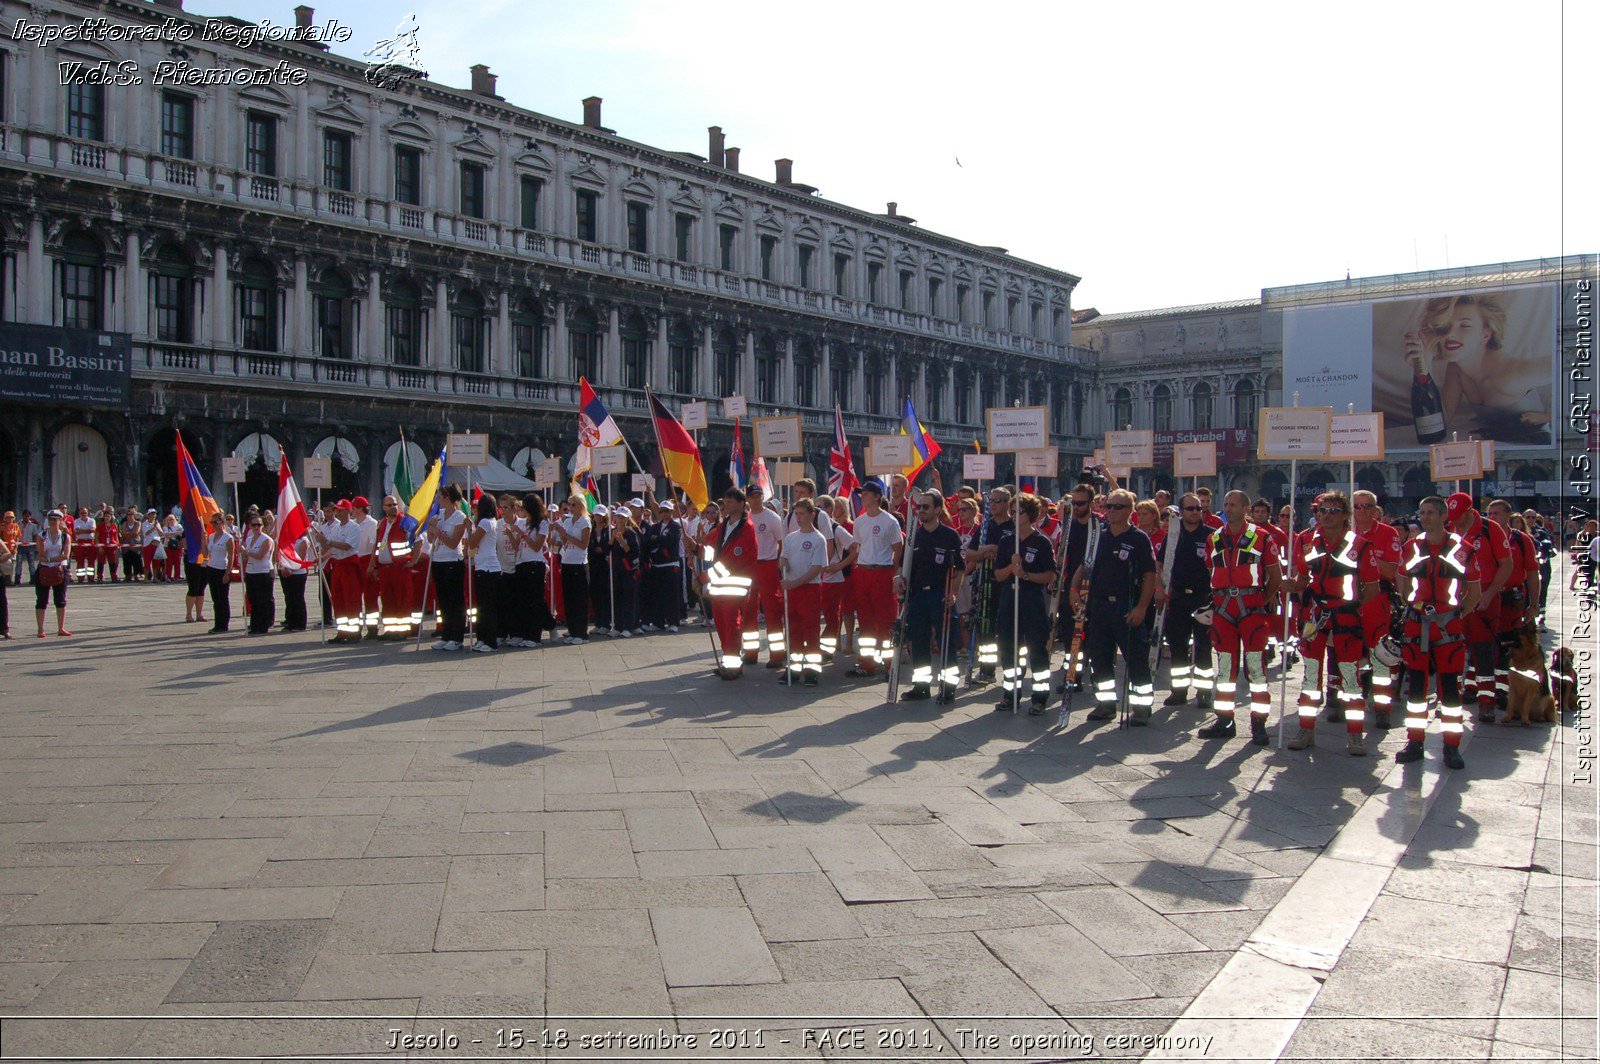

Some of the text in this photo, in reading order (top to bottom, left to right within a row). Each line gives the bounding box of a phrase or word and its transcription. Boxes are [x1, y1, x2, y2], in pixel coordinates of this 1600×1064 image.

[47, 346, 125, 373] Bassiri
[4, 366, 72, 380] delle meteoriti
[1322, 373, 1359, 383] CHANDON
[1176, 431, 1226, 443] Schnabel
